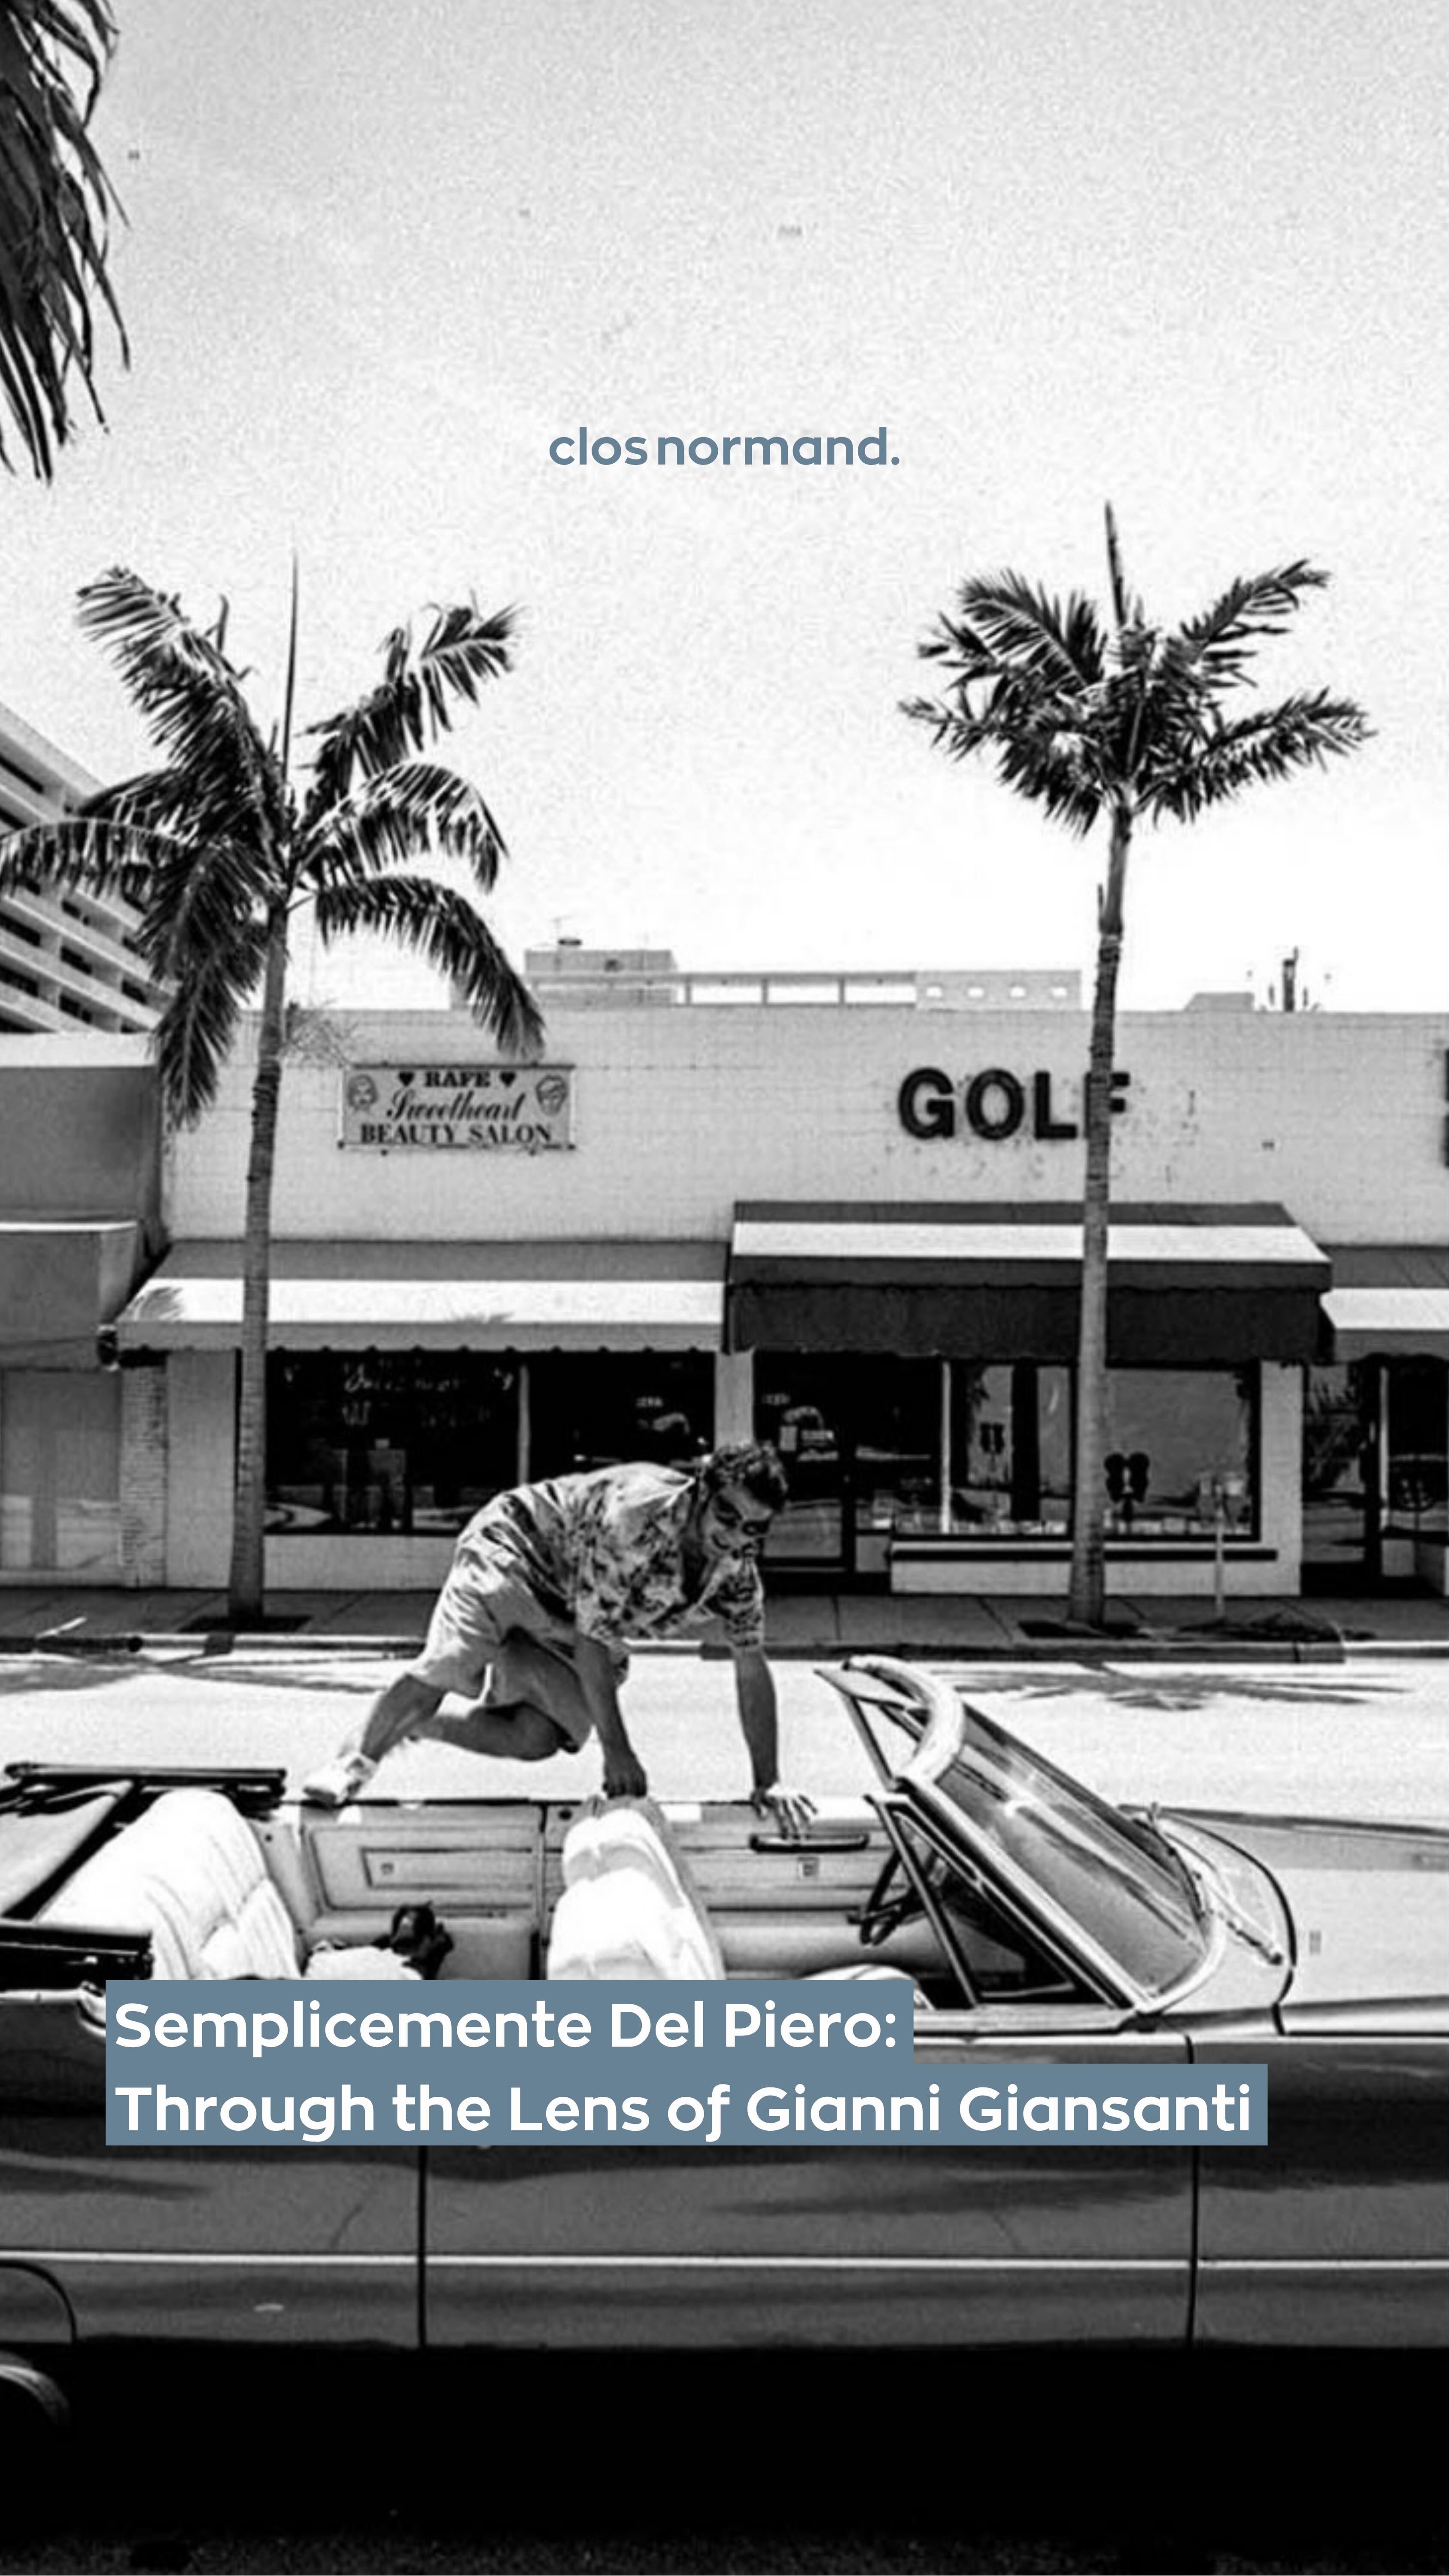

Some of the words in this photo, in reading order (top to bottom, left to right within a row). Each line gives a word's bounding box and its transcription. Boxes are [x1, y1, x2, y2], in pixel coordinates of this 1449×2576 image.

[387, 1088, 526, 1121] Sweetheart
[360, 1124, 454, 1144] BEAUTY
[468, 1124, 552, 1144] SALON
